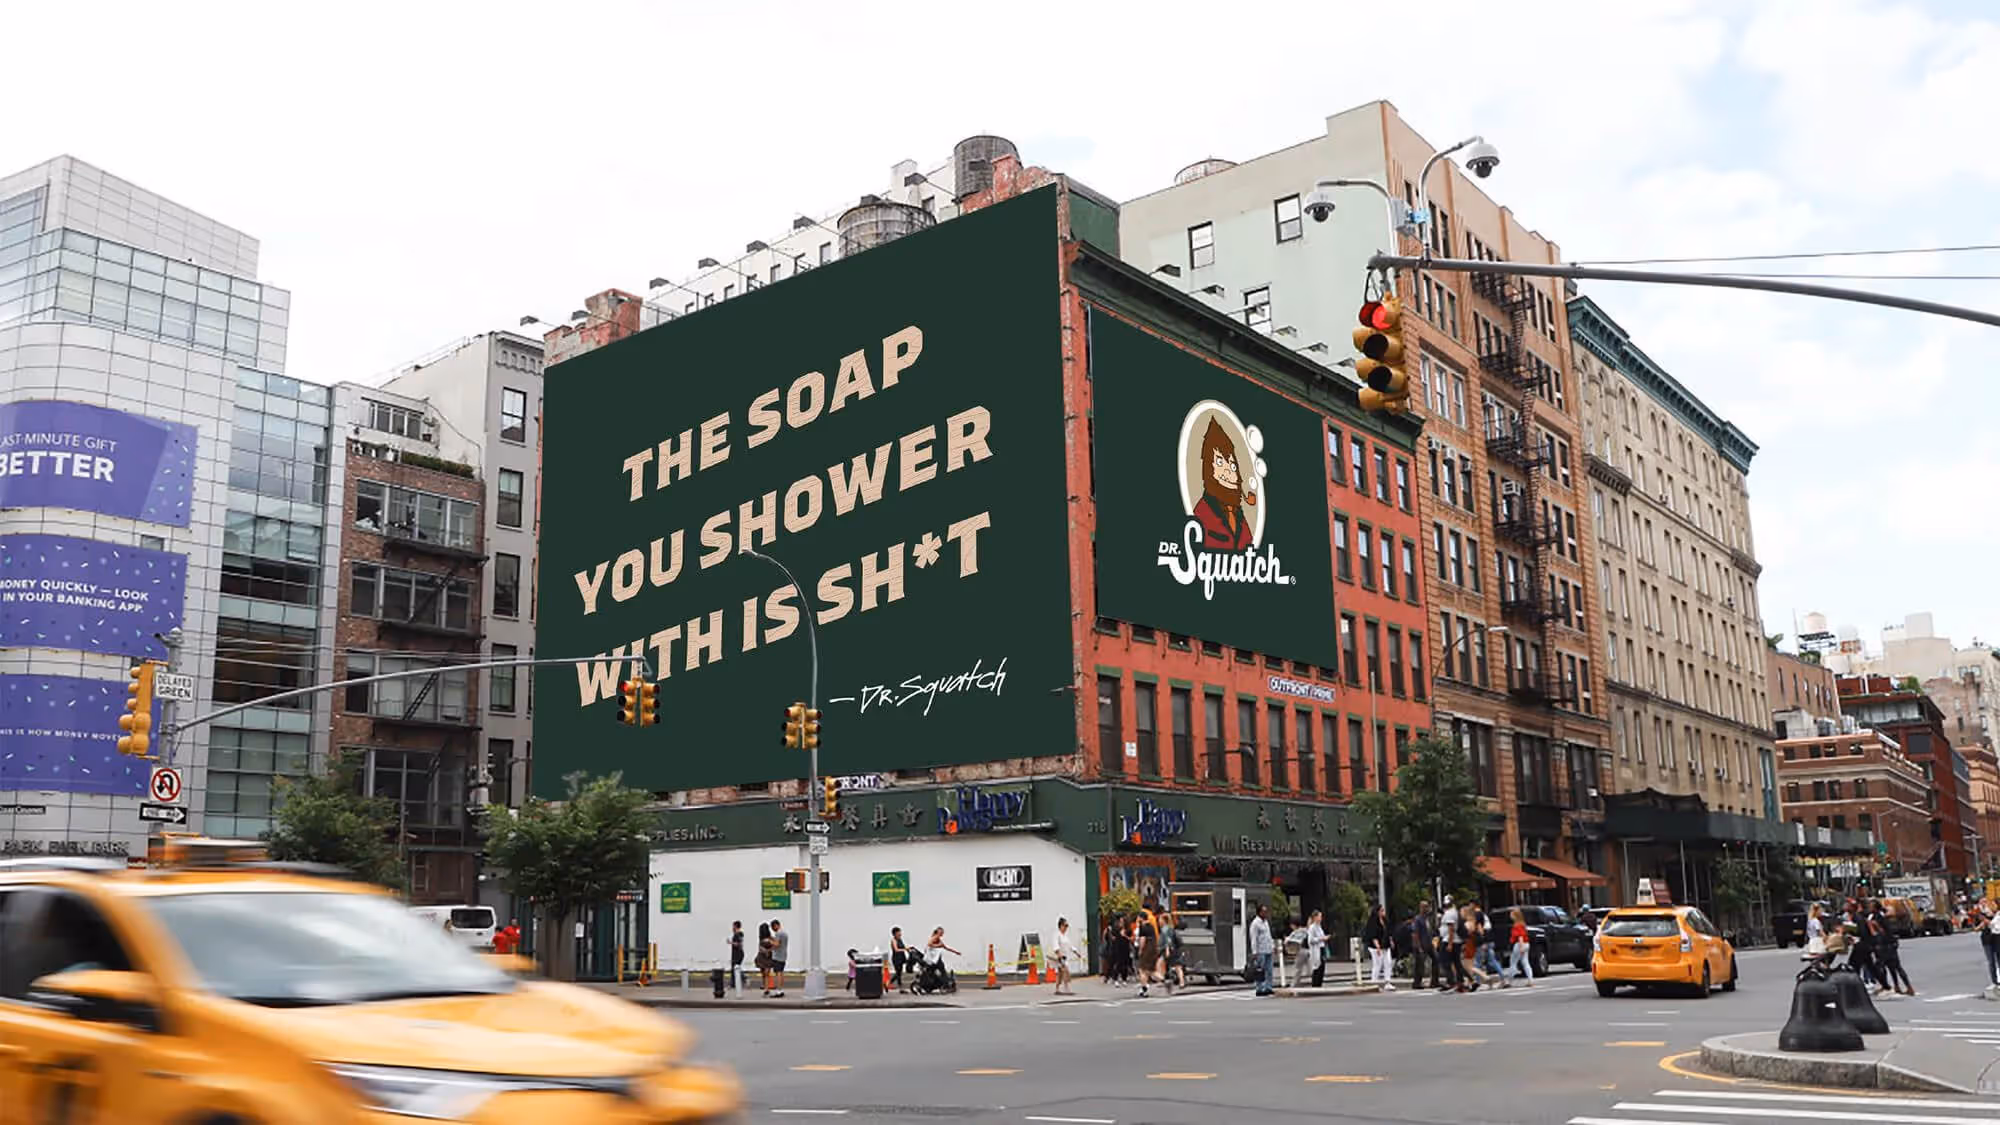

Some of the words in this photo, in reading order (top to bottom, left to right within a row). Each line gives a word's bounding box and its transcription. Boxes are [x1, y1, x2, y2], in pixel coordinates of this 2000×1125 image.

[622, 411, 732, 502] THE
[746, 325, 924, 449] SOAP
[83, 436, 118, 453] GIFT
[574, 529, 685, 616] YOU
[699, 405, 994, 570] SHOWER
[1158, 541, 1182, 556] DR.
[1157, 519, 1290, 601] Squatch
[40, 579, 98, 594] QUICKLY
[114, 587, 149, 602] LOOK
[3, 592, 15, 602] IN
[18, 592, 54, 603] YOUR
[57, 594, 116, 611] BANKING
[117, 602, 144, 614] APP.
[575, 608, 724, 707] WITH
[742, 584, 801, 652] IS
[157, 674, 192, 688] DELAYED
[158, 686, 191, 698] GREEN
[28, 728, 51, 737] HOW
[55, 729, 88, 739] MONEY
[3, 839, 42, 854] PARK
[91, 840, 130, 857] PARK
